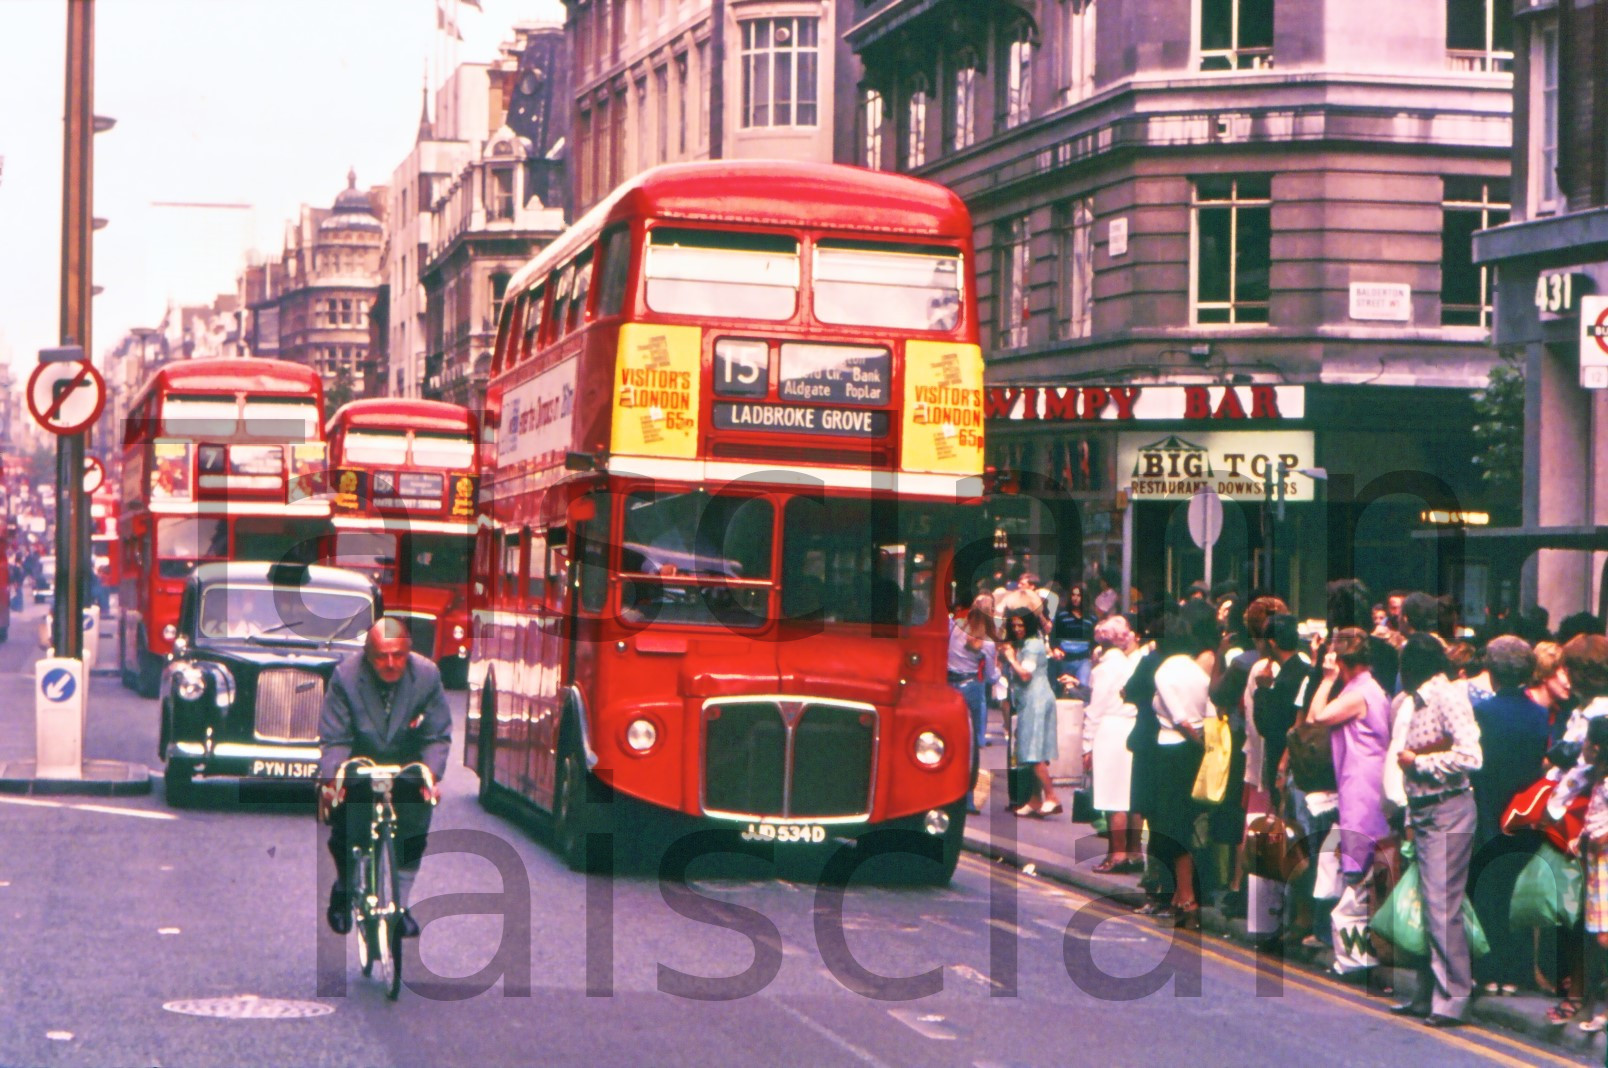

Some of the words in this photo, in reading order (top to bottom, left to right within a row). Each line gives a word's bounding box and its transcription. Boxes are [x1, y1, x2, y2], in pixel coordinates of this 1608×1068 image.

[1356, 298, 1386, 308] STREET
[1535, 272, 1572, 312] 431
[724, 346, 759, 384] 15
[852, 366, 881, 384] Bank
[622, 368, 691, 390] VISITOR'S
[784, 380, 831, 399] Aldgate
[845, 382, 881, 400] Poplar
[634, 389, 690, 411] LONDON
[914, 385, 981, 408] VISITOR'S
[984, 387, 1143, 420] WIMPY
[1184, 386, 1284, 420] BAR
[731, 404, 815, 428] LADBROKE
[822, 409, 873, 432] GROVE
[926, 406, 981, 428] LONDON
[959, 428, 985, 454] 65p
[1143, 453, 1203, 478] BIG
[1223, 453, 1299, 478] TOP
[1218, 481, 1298, 495] DOWNSRS
[253, 761, 285, 776] PYN
[778, 825, 826, 843] 534D
